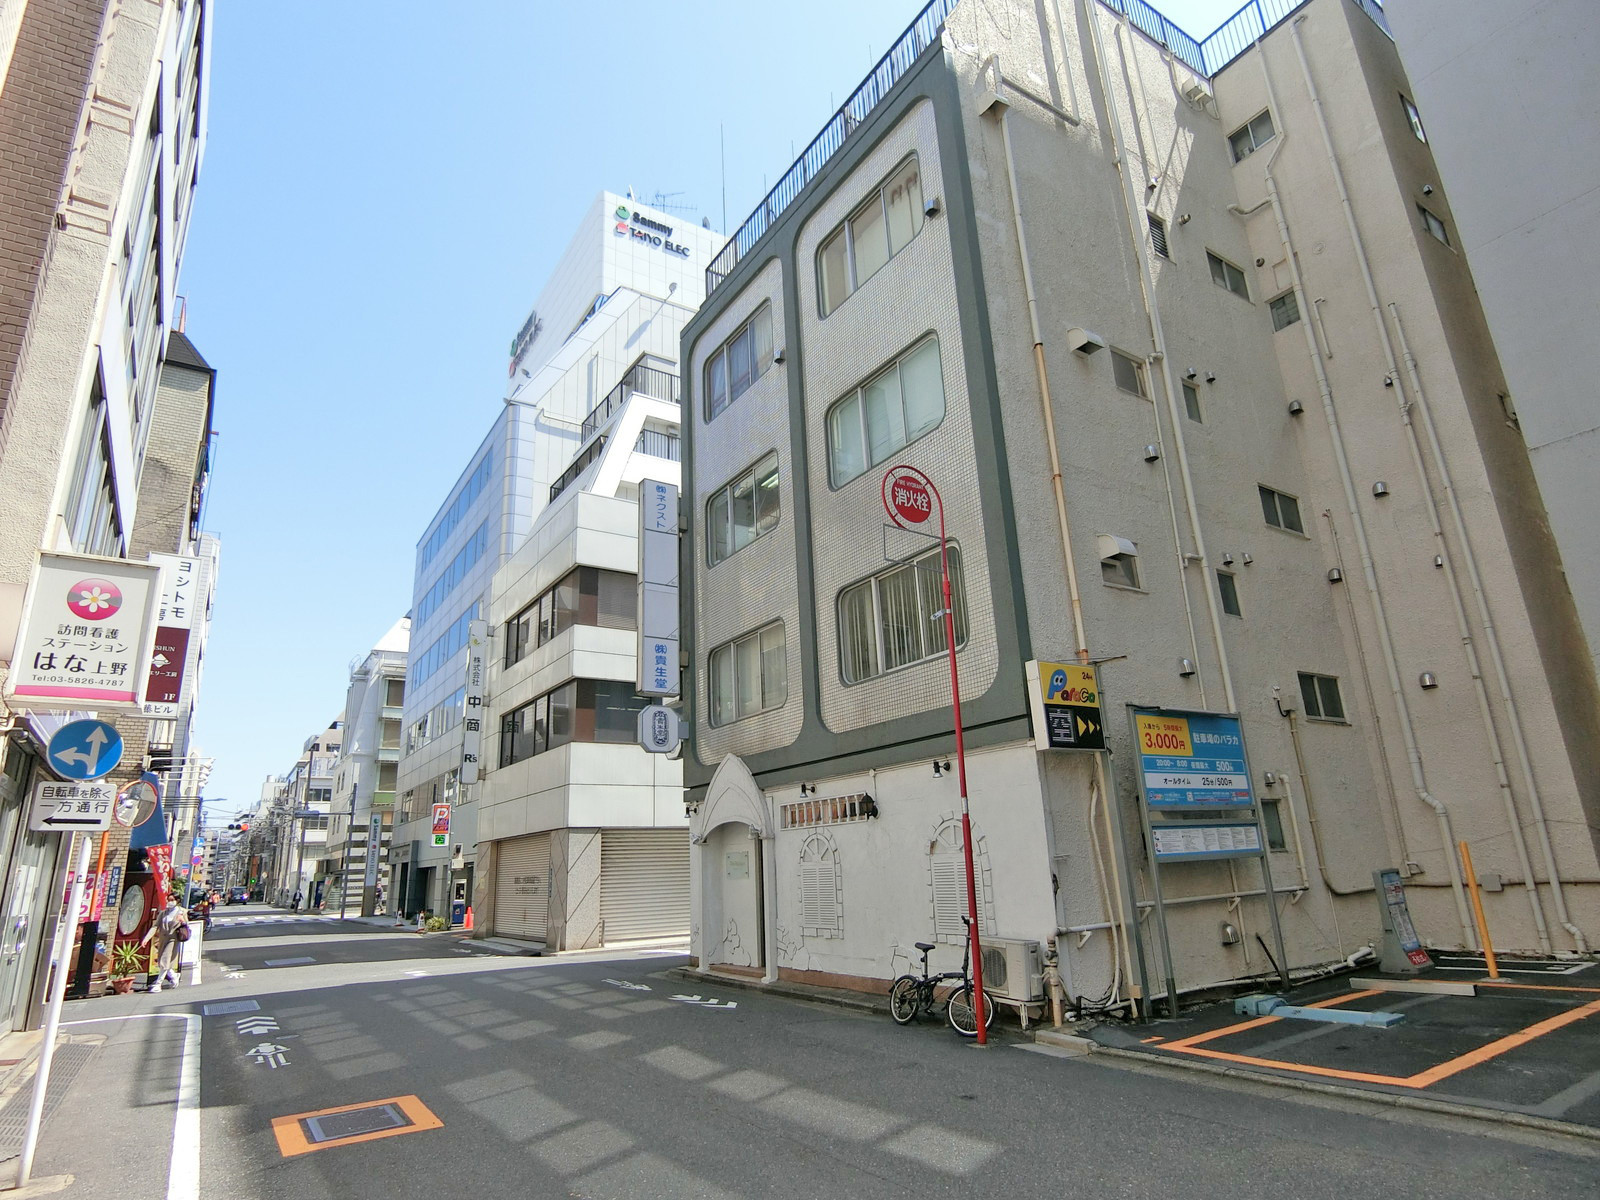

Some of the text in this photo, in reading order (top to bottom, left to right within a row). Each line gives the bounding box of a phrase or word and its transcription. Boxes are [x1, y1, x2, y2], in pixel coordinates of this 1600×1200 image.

[632, 211, 673, 238] Sammy
[629, 227, 690, 257] TAIYO ELEC
[894, 486, 929, 512] 消火栓
[170, 561, 192, 619] ヨシトモ
[57, 624, 119, 640] 訪問看護
[42, 637, 129, 653] ステーション
[33, 652, 128, 676] はな 上野
[32, 674, 125, 687] Tel:03-5826-4787
[164, 693, 176, 701] 1F
[466, 656, 481, 732] 株式会社 中商
[1144, 732, 1186, 750] 3,000円
[42, 786, 111, 799] 自転車を除く
[40, 800, 109, 814] 一方通行
[433, 807, 448, 824] P
